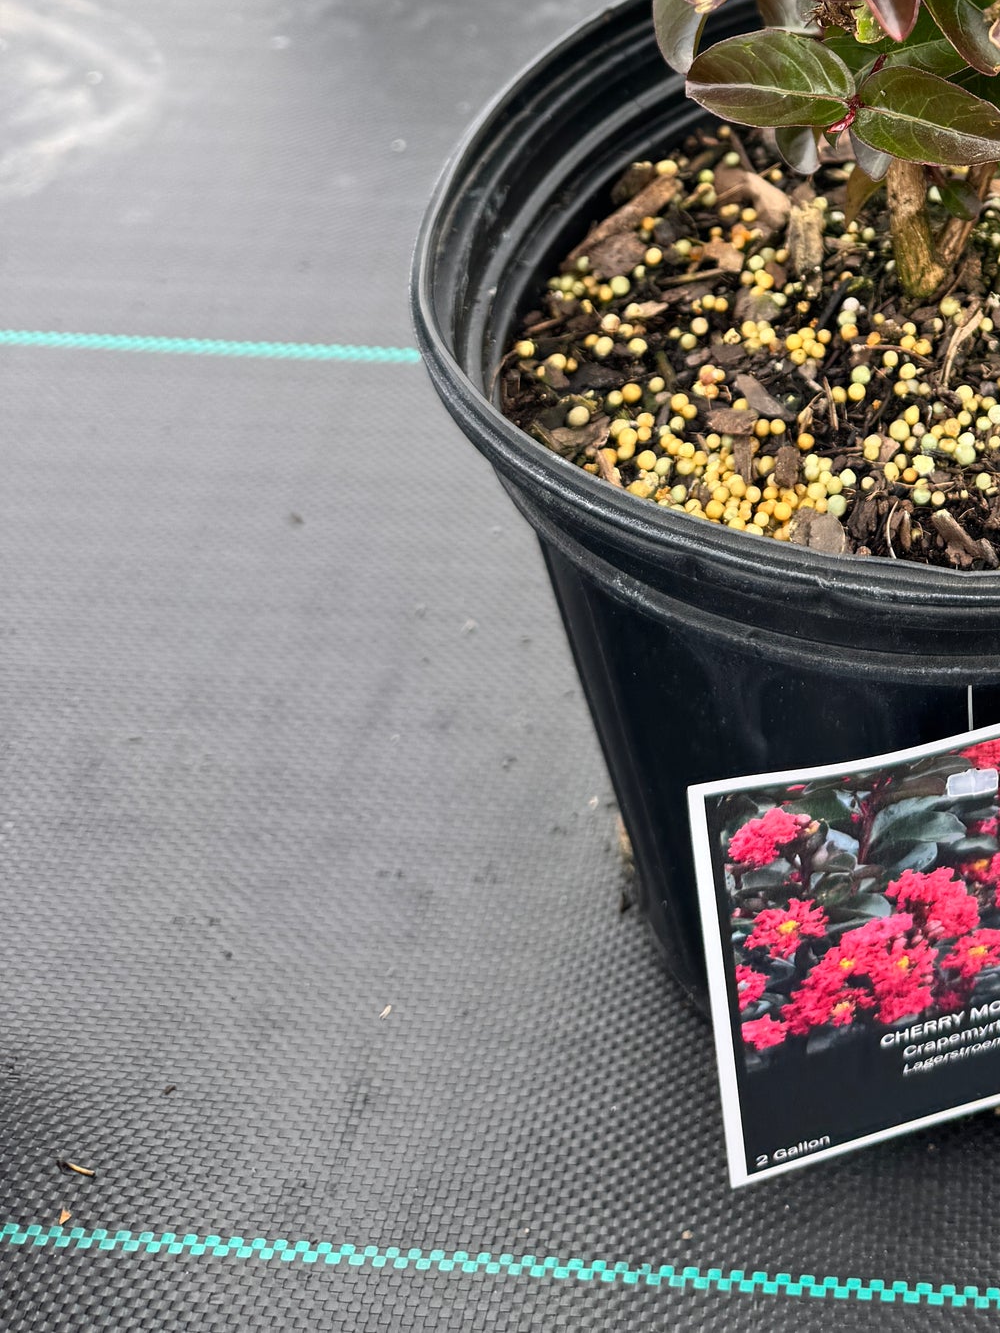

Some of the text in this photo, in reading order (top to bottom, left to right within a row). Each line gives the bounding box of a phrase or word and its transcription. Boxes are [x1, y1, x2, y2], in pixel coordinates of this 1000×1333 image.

[880, 1011, 965, 1048] CHERRY
[755, 1135, 831, 1167] 2 Gallon
